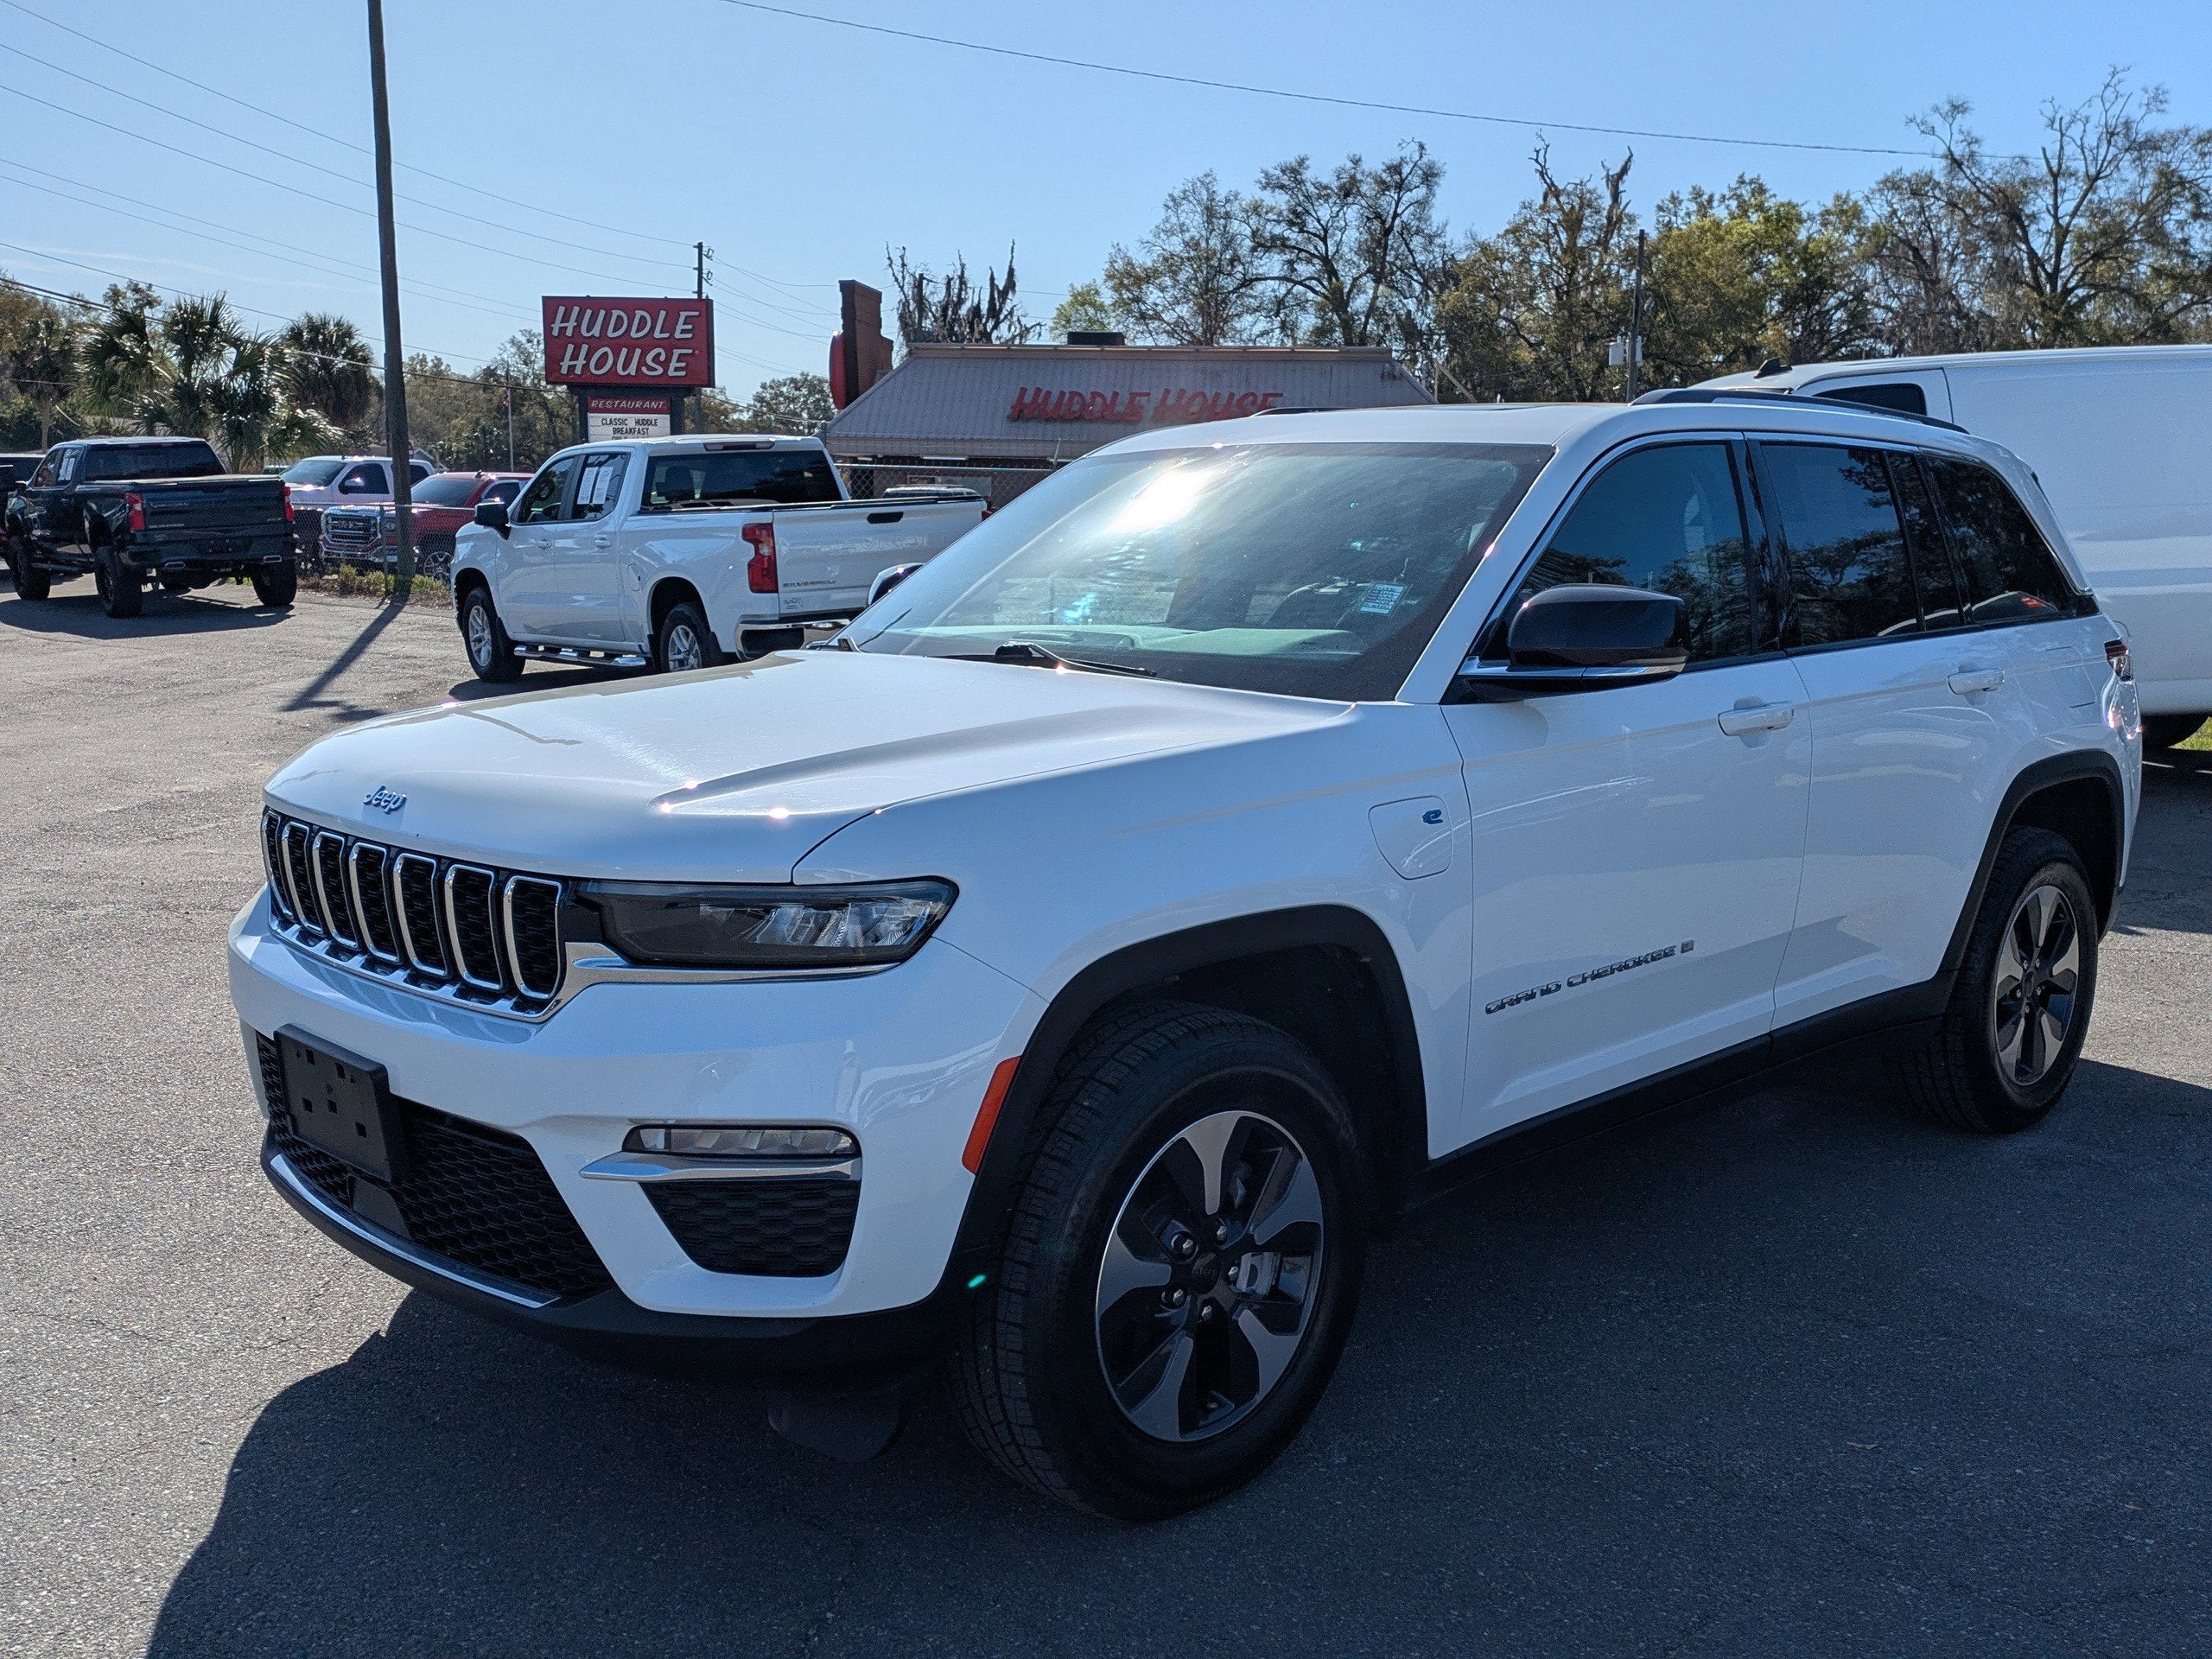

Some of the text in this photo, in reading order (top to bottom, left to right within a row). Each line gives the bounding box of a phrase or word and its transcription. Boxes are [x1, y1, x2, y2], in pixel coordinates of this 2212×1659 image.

[551, 305, 700, 339] HUDDLE
[560, 343, 693, 377] HOUSE
[591, 399, 664, 410] RESTAURANT
[1007, 387, 1151, 423] HUDDLE
[601, 417, 658, 427] CLASSIC HUDDLE
[612, 427, 650, 435] BREAKFAST
[363, 785, 407, 815] Jeep
[1484, 944, 1677, 1015] GRAND CHEROKEE
